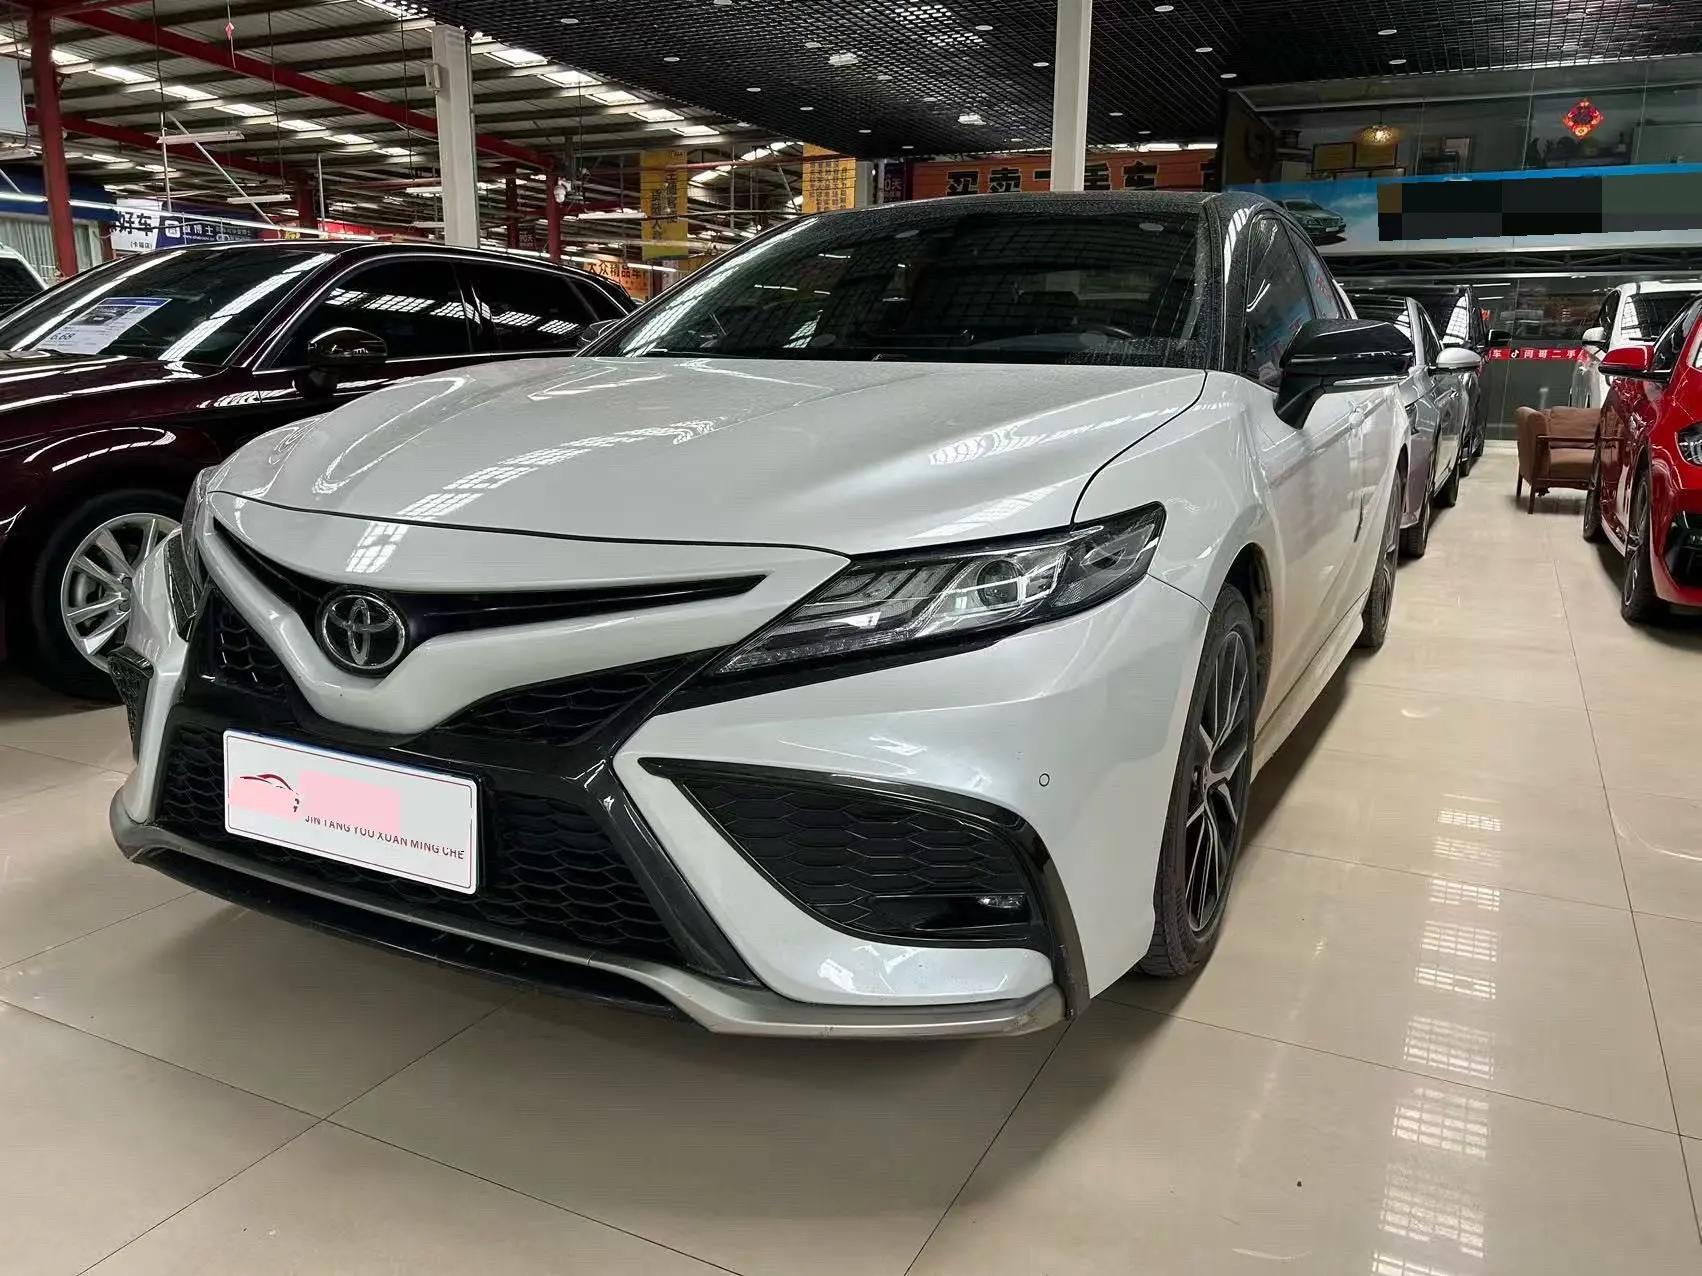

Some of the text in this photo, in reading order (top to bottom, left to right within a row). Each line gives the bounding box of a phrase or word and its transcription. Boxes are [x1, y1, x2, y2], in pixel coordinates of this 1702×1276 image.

[377, 831, 408, 847] XUAN
[410, 839, 440, 854] MING
[442, 846, 465, 860] CHE
